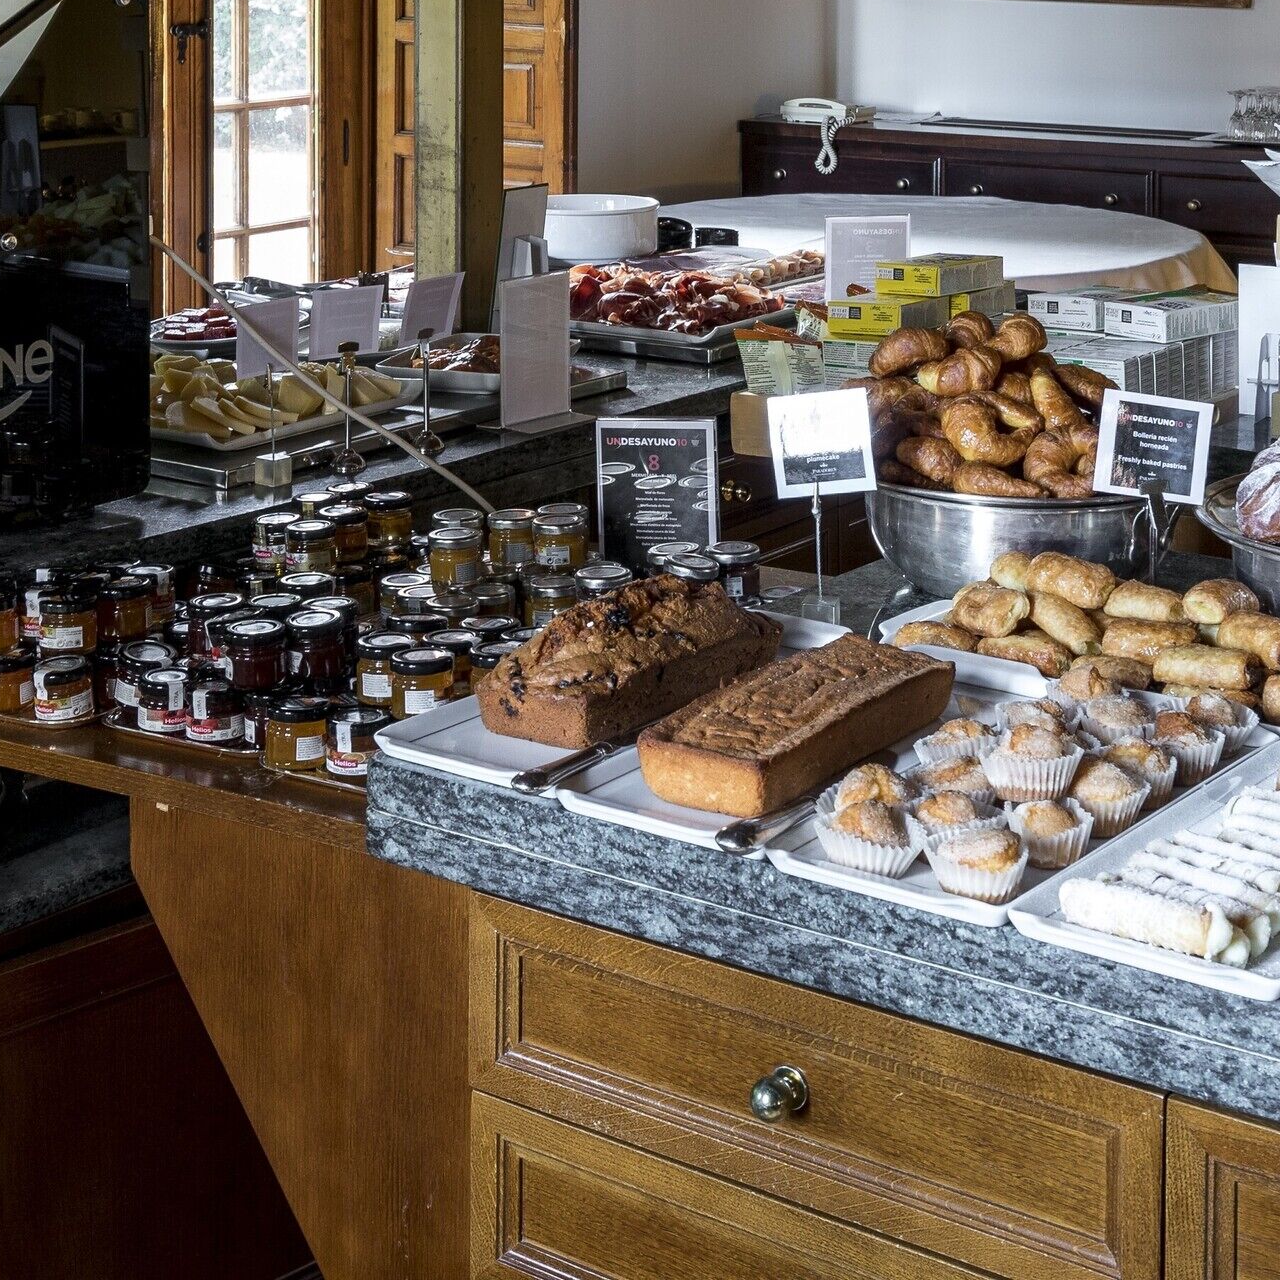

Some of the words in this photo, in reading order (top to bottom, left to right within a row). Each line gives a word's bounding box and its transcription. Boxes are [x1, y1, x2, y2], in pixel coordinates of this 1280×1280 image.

[1140, 440, 1169, 451] horneada
[649, 454, 660, 470] 8
[1118, 454, 1141, 465] Freshly
[1142, 458, 1162, 467] baked
[1162, 461, 1187, 471] pastries
[191, 725, 212, 733] Helios
[334, 759, 357, 767] Helios
